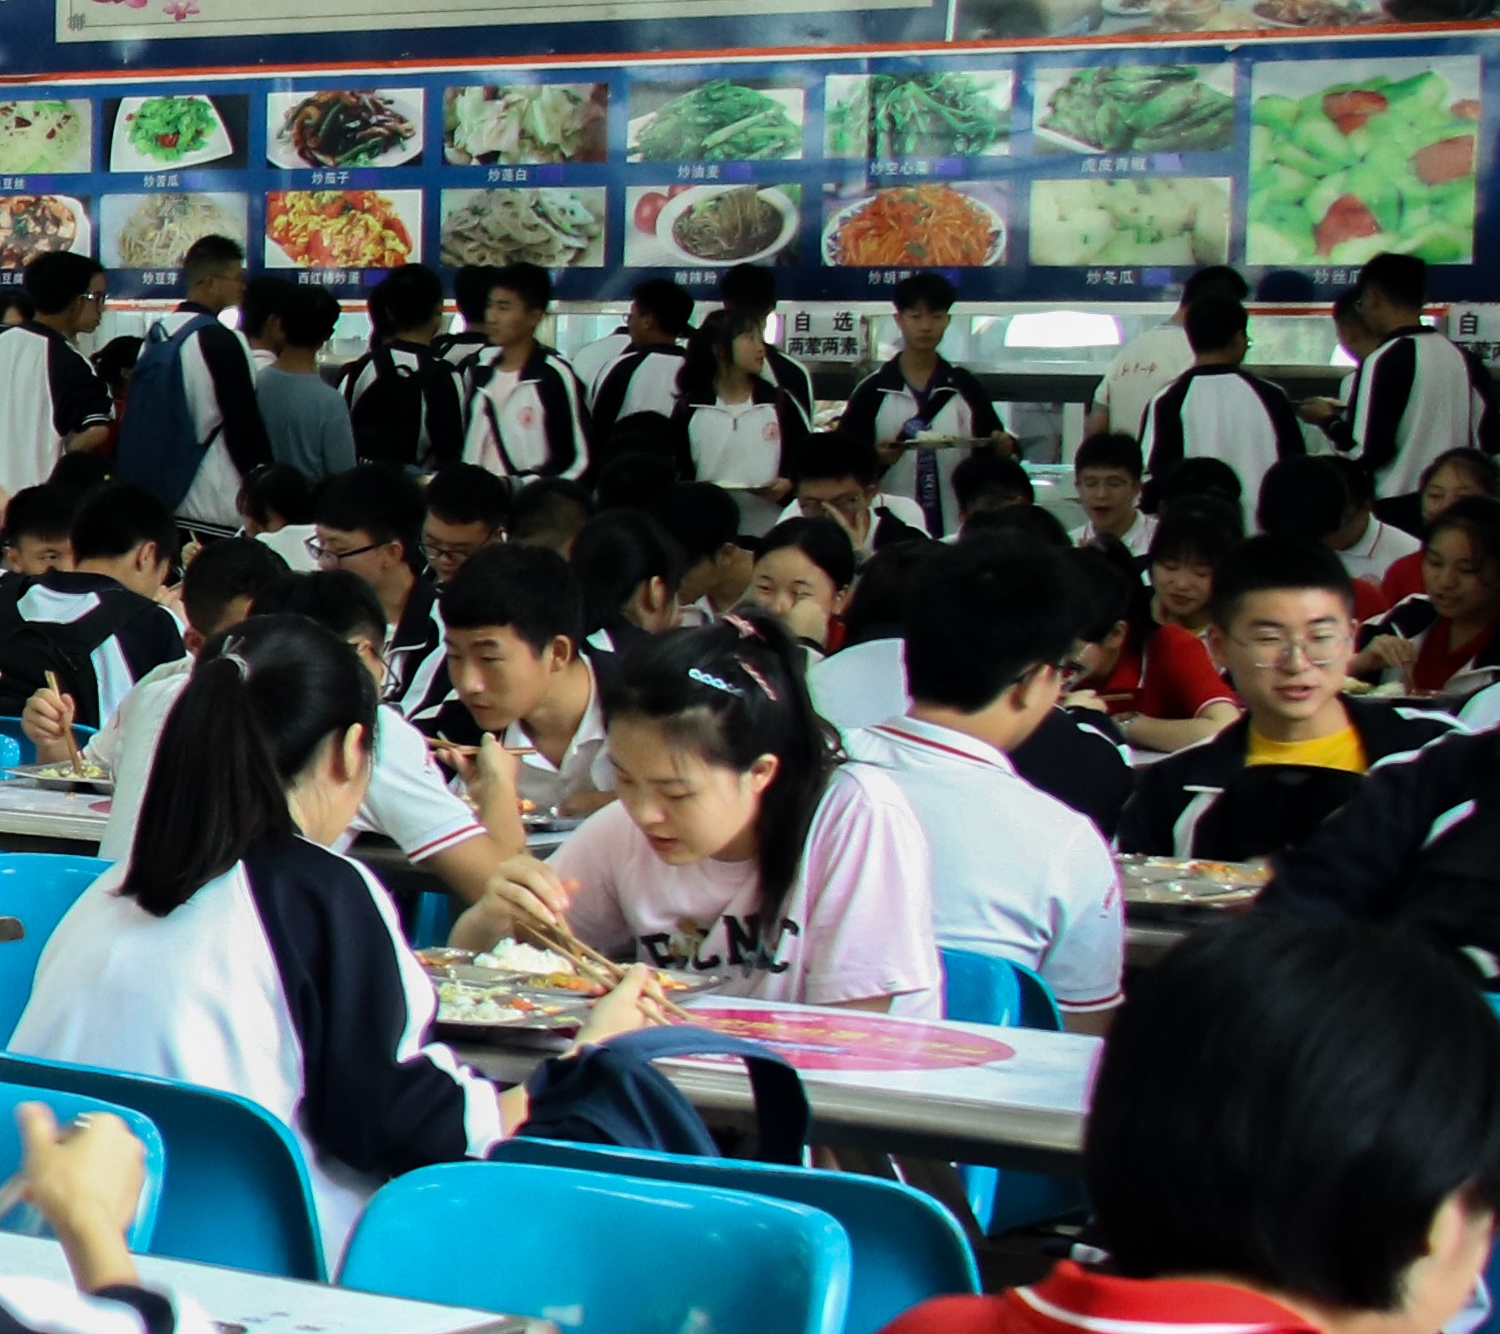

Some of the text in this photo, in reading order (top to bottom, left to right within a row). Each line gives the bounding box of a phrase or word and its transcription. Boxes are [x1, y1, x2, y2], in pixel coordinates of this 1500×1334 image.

[311, 171, 349, 185] 炒茄子
[677, 165, 720, 180] 炒油麦
[143, 174, 179, 188] 炒苦瓜
[142, 271, 179, 286] 炒豆芽
[674, 270, 717, 286] 酸辣粉
[868, 269, 924, 285] 炒胡萝
[1085, 269, 1135, 285] 炒冬瓜
[793, 310, 855, 331] 自选
[1459, 311, 1479, 335] 自
[787, 336, 859, 356] 两荤两素
